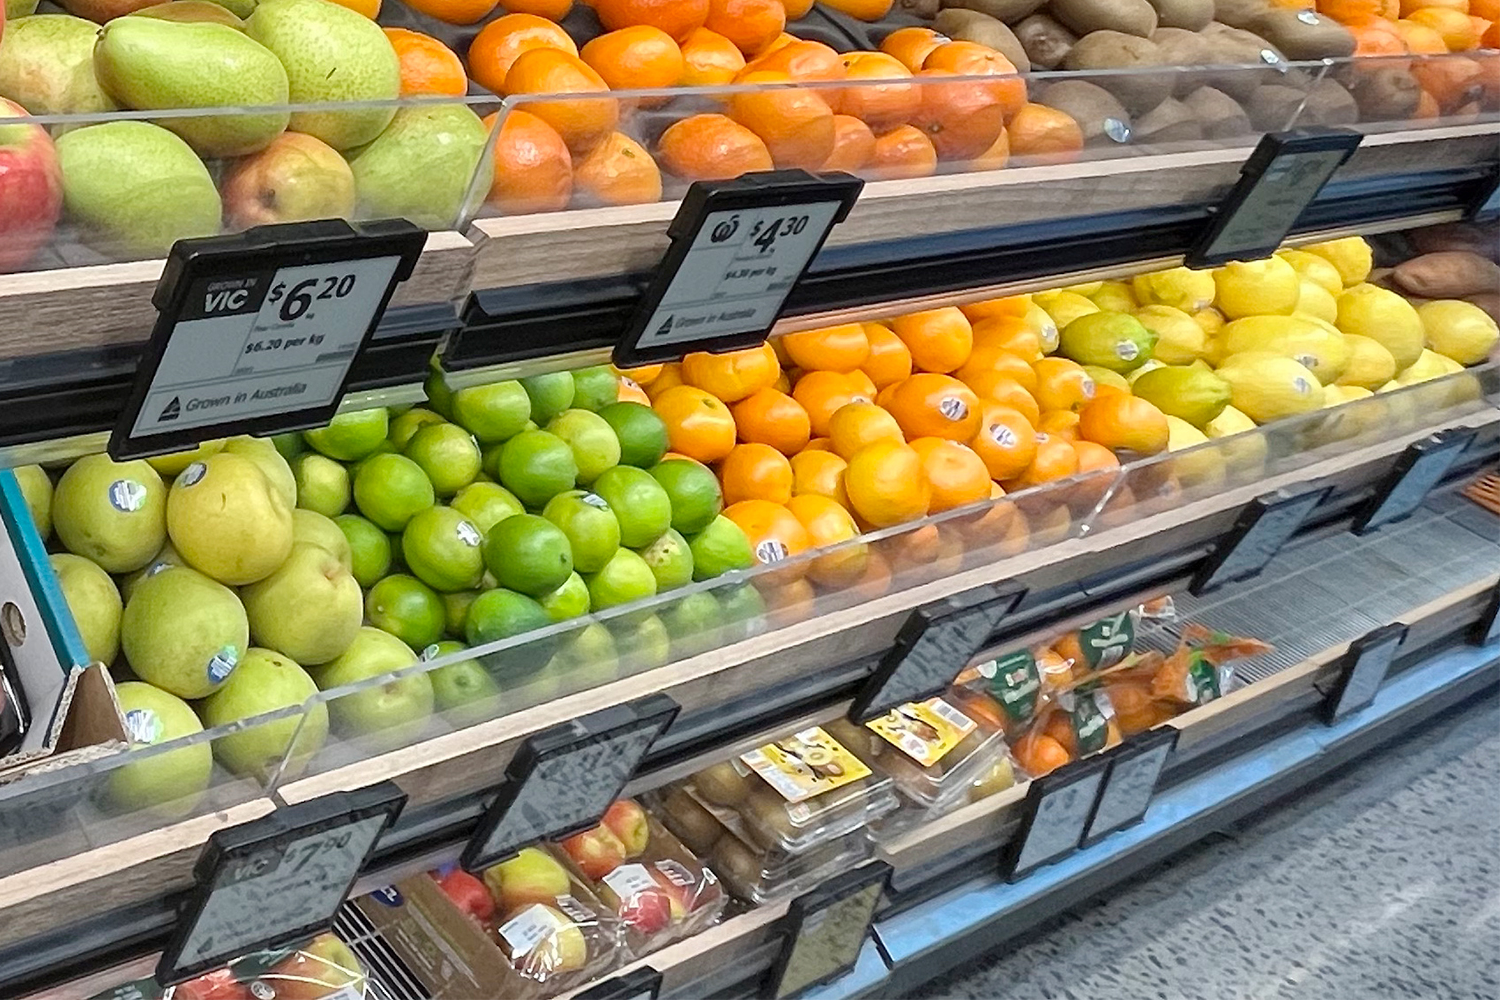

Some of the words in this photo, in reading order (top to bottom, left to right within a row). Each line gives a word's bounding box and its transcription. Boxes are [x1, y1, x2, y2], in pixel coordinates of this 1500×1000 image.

[204, 289, 248, 313] VIC
[245, 338, 282, 354] $6.20
[284, 336, 306, 350] per
[309, 333, 326, 345] kg
[185, 396, 231, 412] Grown
[234, 392, 247, 403] in
[251, 383, 307, 400] Australia
